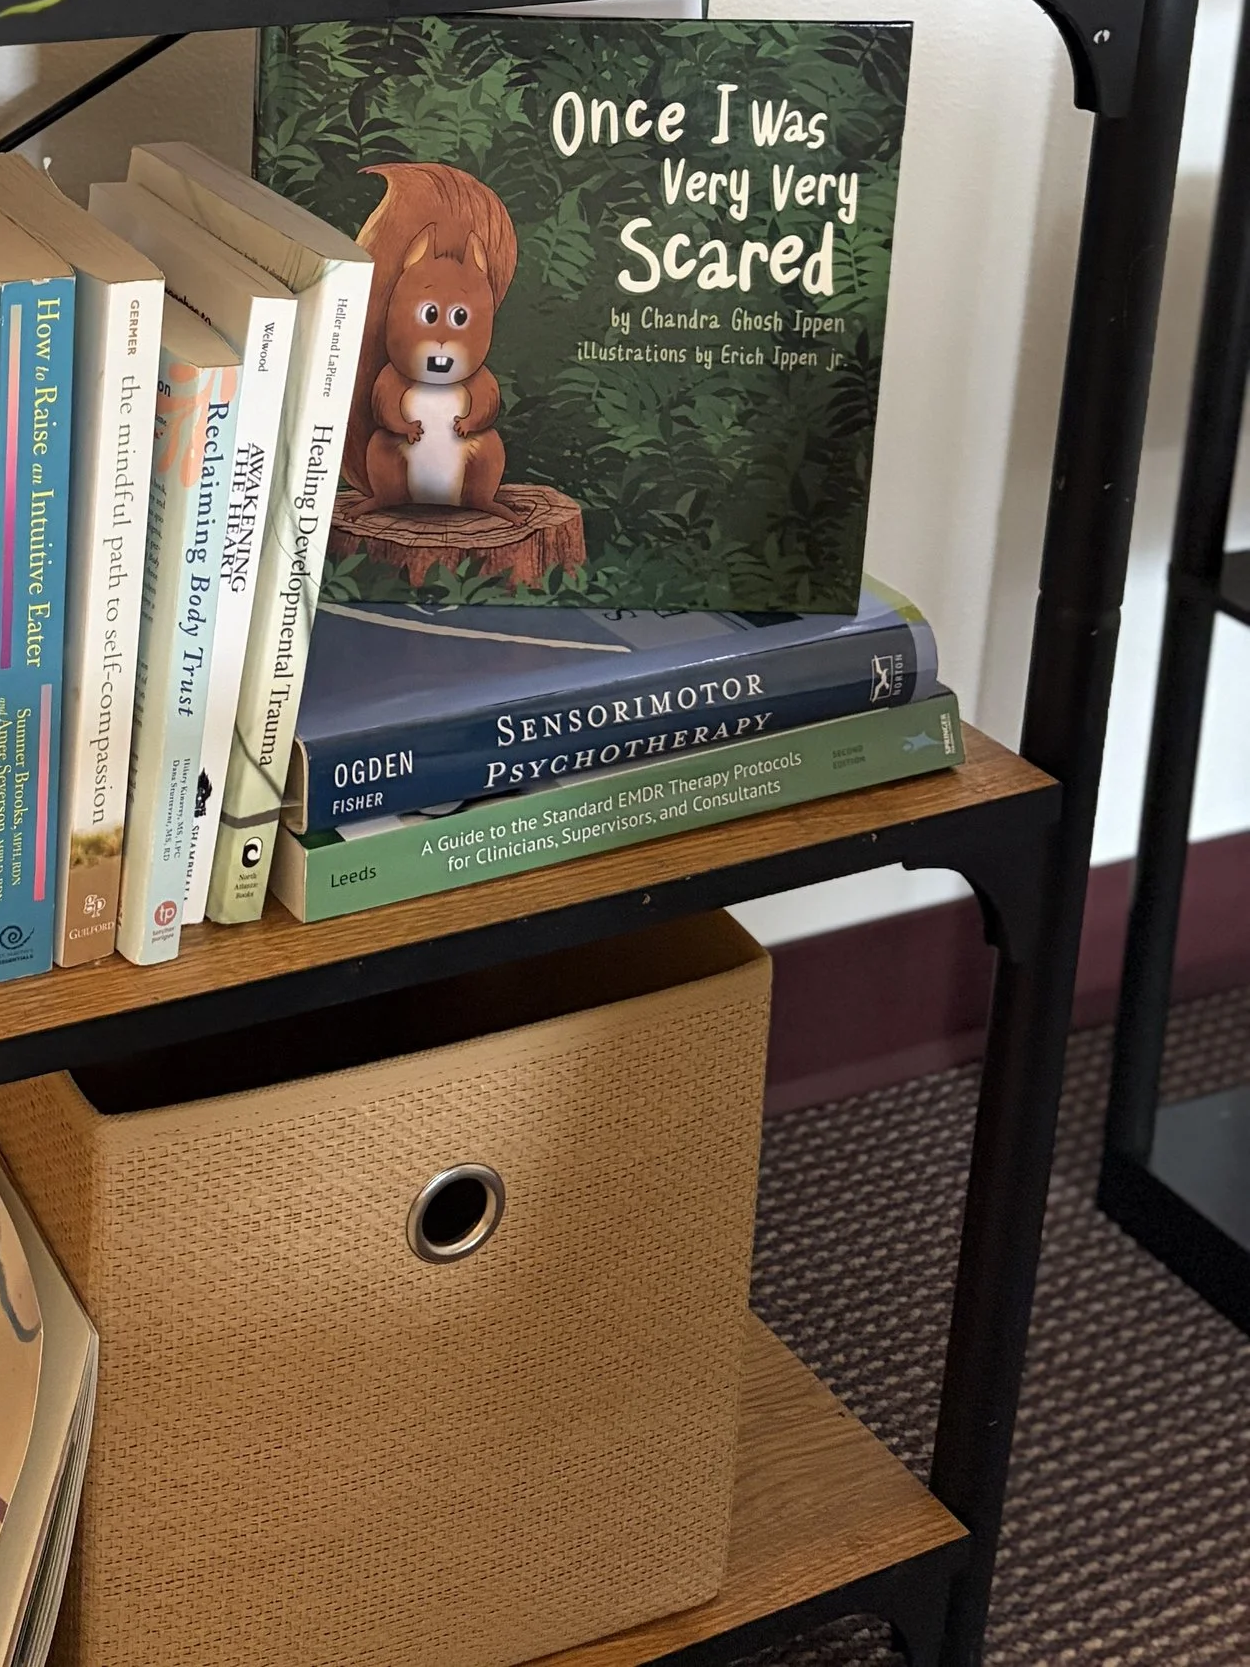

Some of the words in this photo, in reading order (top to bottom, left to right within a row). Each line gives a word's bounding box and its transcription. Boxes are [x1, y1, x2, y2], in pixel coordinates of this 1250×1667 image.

[552, 91, 686, 157] Once
[710, 83, 739, 145] I
[751, 98, 829, 150] Was
[663, 156, 750, 222] Very
[772, 163, 859, 225] Very
[617, 216, 835, 297] Scared
[35, 297, 61, 361] How
[127, 299, 140, 356] GERMER
[331, 334, 340, 352] and
[335, 297, 349, 331] Heller
[611, 307, 630, 335] by
[641, 305, 720, 330] Chandra
[731, 308, 783, 332] Ghosh
[793, 309, 845, 338] Ippen
[35, 364, 48, 381] to
[257, 321, 276, 373] Welwood
[322, 353, 340, 398] LaPierre
[577, 341, 686, 363] illustrations
[695, 343, 712, 370] by
[720, 344, 764, 366] Erich
[772, 345, 818, 371] Ippen
[826, 349, 848, 372] jr.
[33, 384, 58, 456] Raise
[119, 374, 141, 415] the
[31, 463, 43, 485] an
[111, 424, 135, 529] mindful
[185, 401, 231, 564] Reclaiming
[232, 446, 251, 495] THE
[294, 424, 334, 511] Healing
[28, 490, 55, 596] Intuitive
[219, 497, 245, 584] HEART
[231, 442, 265, 593] AWAKENING
[103, 536, 130, 591] path
[105, 596, 122, 623] to
[177, 574, 210, 637] Body
[271, 514, 320, 679] Developmental
[26, 602, 52, 668] Eater
[177, 647, 204, 717] Trust
[893, 652, 903, 697] NORTON
[16, 707, 31, 767] Sumner
[89, 629, 123, 825] self-compassion
[259, 682, 291, 767] Trauma
[334, 749, 413, 789] OGDEN
[496, 673, 765, 747] SENSORIMOTOR
[332, 791, 384, 815] FISHER
[483, 711, 773, 789] PSYCHOTHERAPY
[10, 771, 29, 831] Brooks,
[421, 840, 433, 856] A
[438, 830, 484, 853] Guide
[490, 825, 506, 840] to
[511, 816, 538, 835] the
[542, 796, 613, 827] Standard
[618, 786, 664, 810] EMDR
[669, 770, 730, 797] Therapy
[734, 751, 802, 781] Protocols
[448, 854, 470, 872] for
[476, 833, 559, 865] Clinicians,
[561, 809, 657, 846] Supervisors,
[659, 797, 688, 821] and
[693, 779, 781, 812] Consultants
[331, 865, 377, 888] Leeds
[68, 921, 115, 941] GUILFORD
